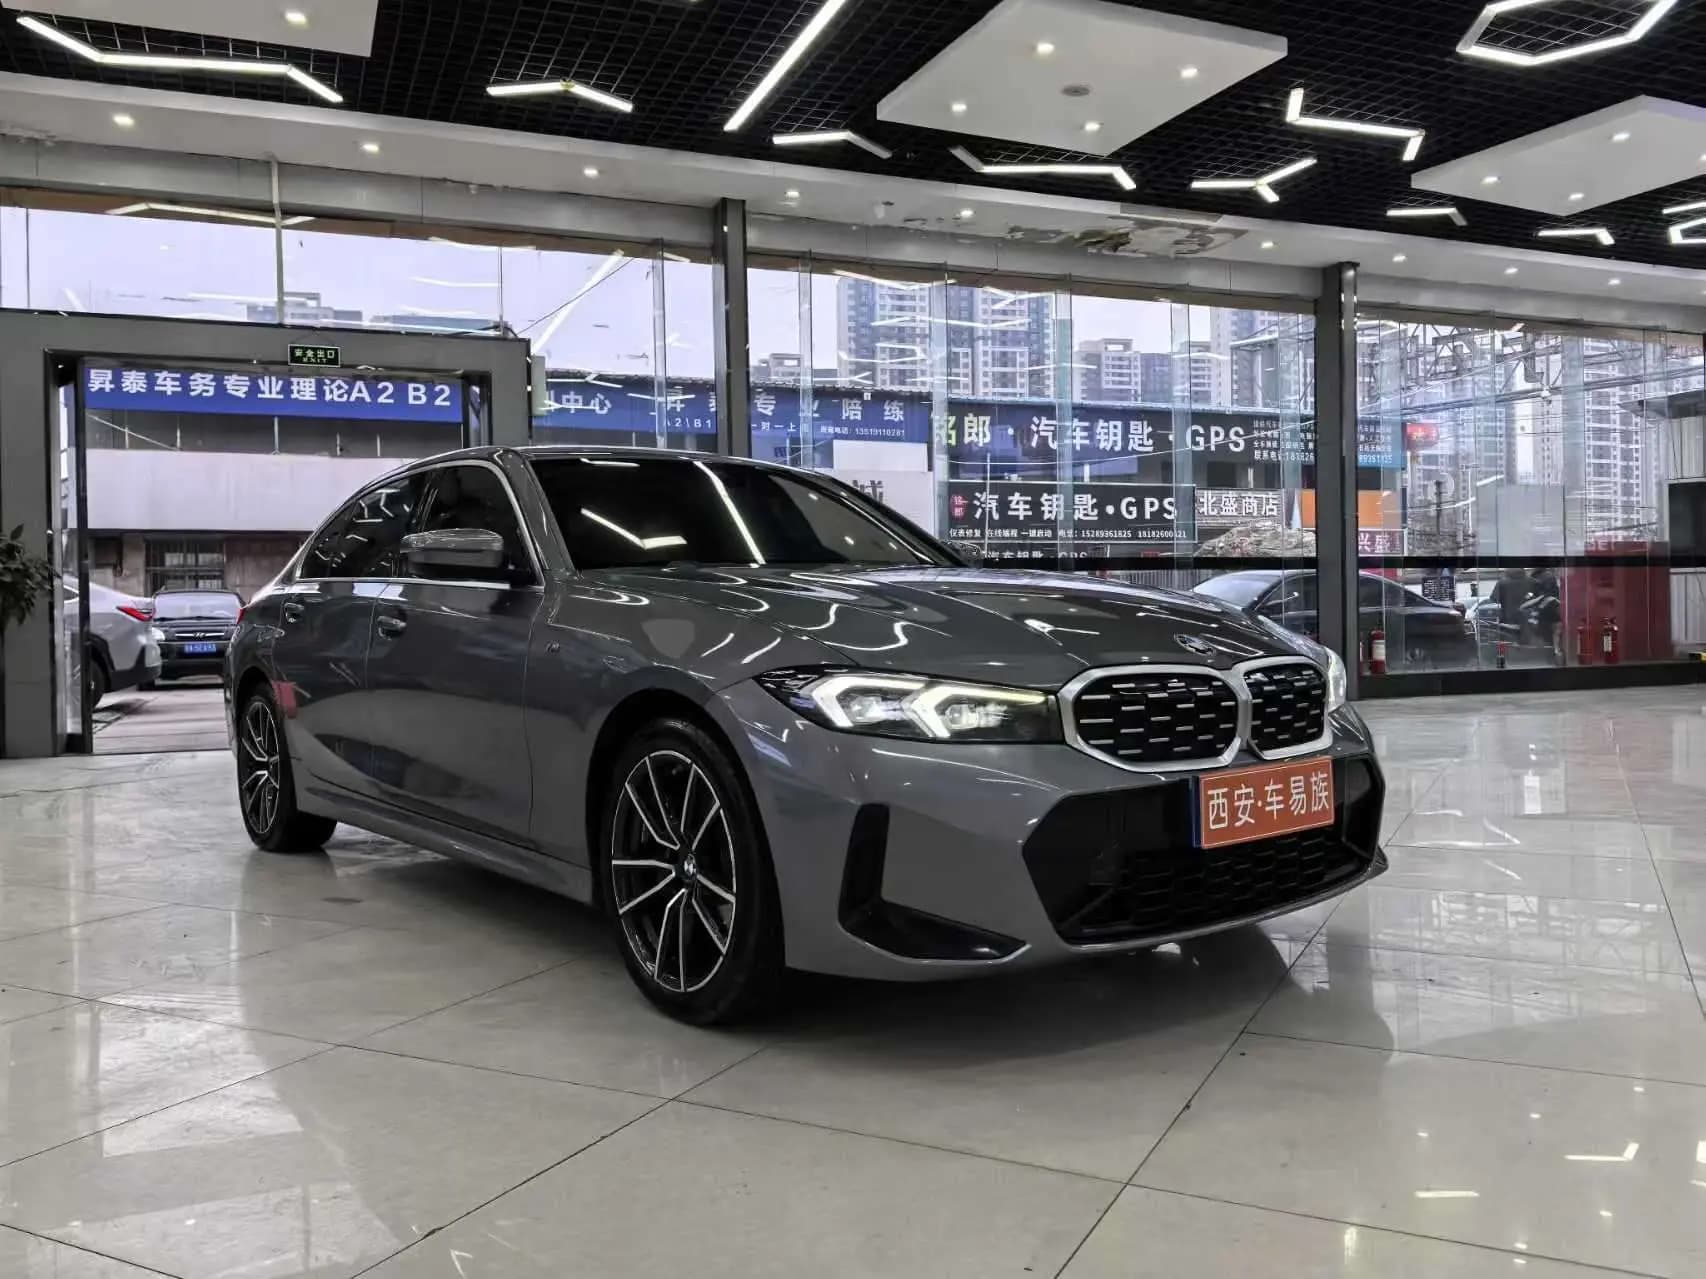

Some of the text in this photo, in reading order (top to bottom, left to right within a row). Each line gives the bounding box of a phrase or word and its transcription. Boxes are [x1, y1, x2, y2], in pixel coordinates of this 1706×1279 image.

[295, 349, 335, 359] 安全出口
[1199, 490, 1278, 516] 北盛商店
[1208, 771, 1329, 830] 西安·车易族
